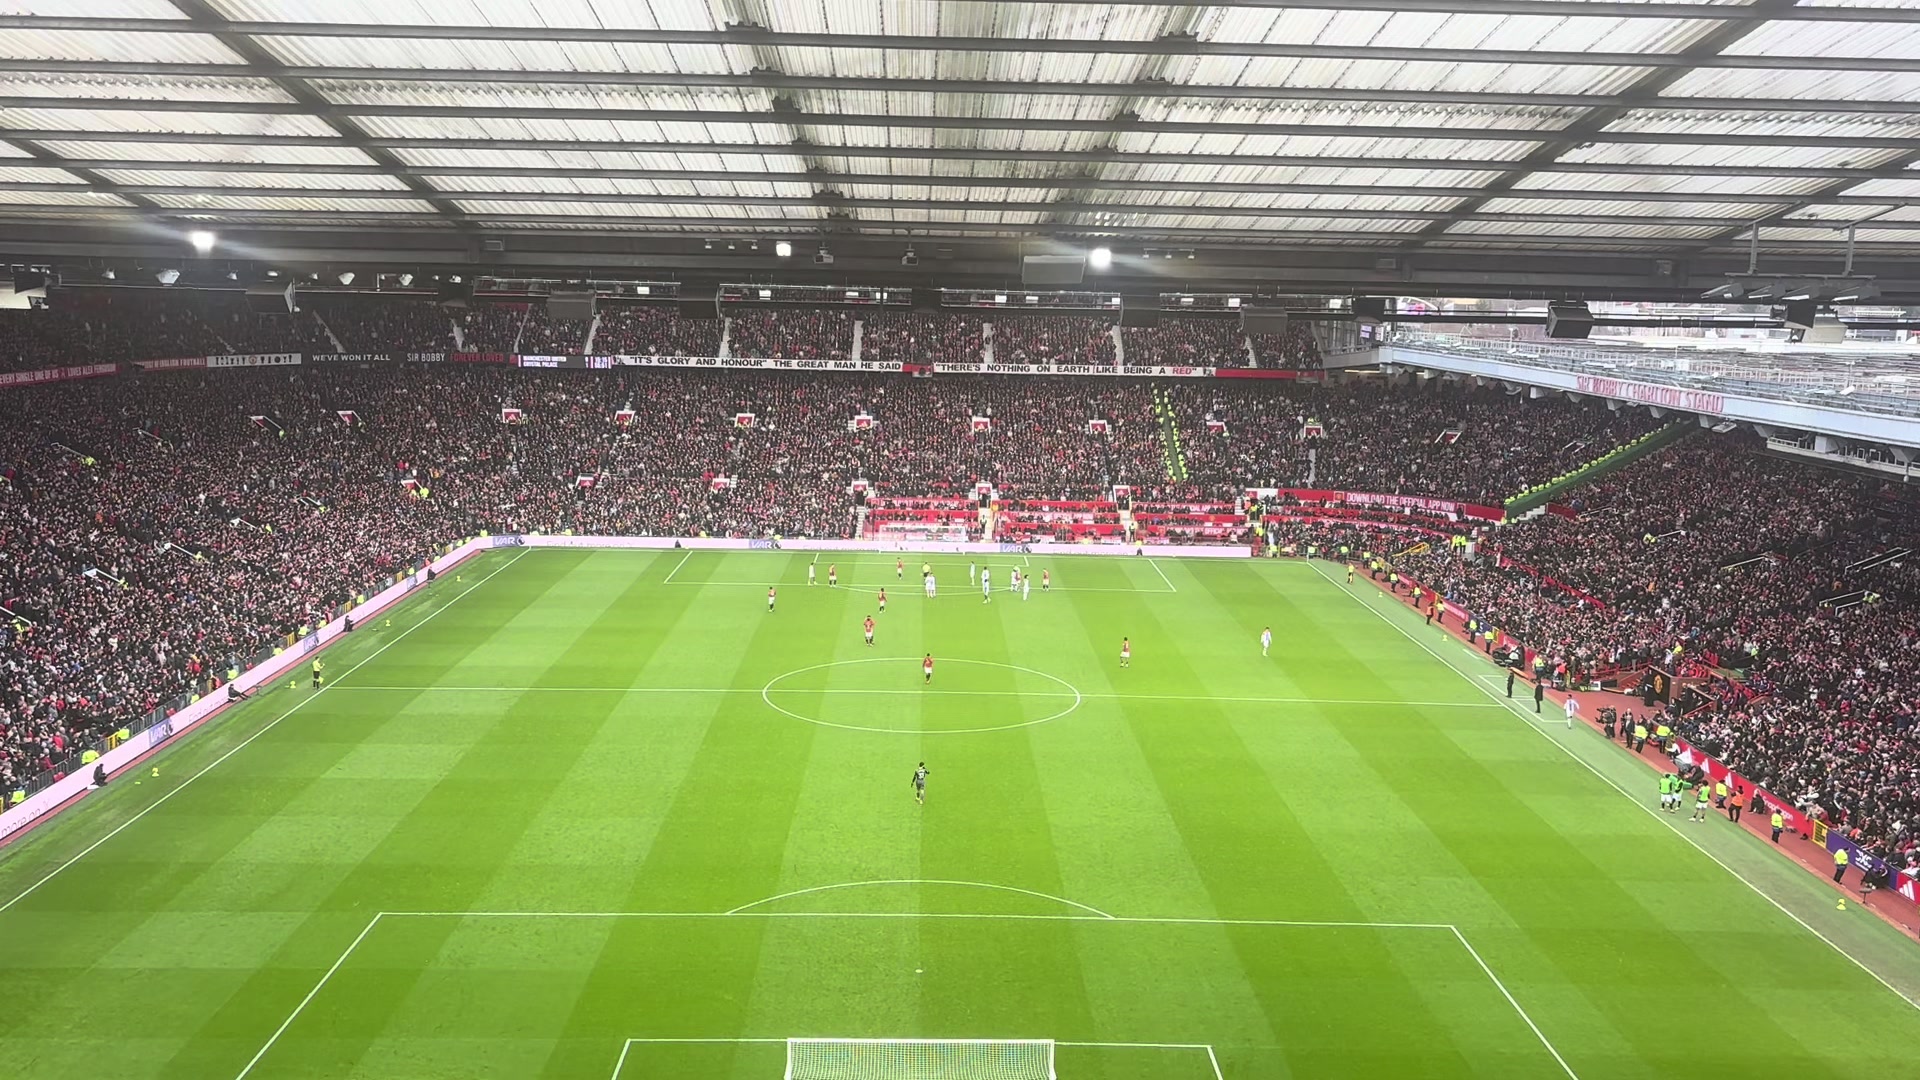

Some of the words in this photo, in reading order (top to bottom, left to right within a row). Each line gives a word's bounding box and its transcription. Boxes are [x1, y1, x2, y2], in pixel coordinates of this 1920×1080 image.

[312, 354, 339, 362] WE'VE
[407, 353, 419, 362] SIR
[421, 353, 445, 362] BOBBY
[630, 356, 652, 364] "IT'S
[658, 357, 690, 365] GLORY
[696, 358, 716, 366] AND
[721, 358, 767, 367] HONOUR"
[773, 359, 792, 368] THE
[797, 360, 829, 369] GREAT
[834, 361, 856, 369] MAN
[860, 362, 873, 370] HE
[878, 362, 901, 370] SAID
[935, 363, 981, 371] "THERE'S
[986, 364, 1031, 372] NOTHING
[1036, 365, 1050, 373] ON
[1057, 365, 1090, 373] EARTH
[1096, 366, 1118, 374] LIKE
[1123, 366, 1152, 375] BEING
[1158, 367, 1166, 375] A
[1172, 367, 1197, 375] RED"
[16, 371, 34, 383] SINGLE
[1577, 375, 1590, 391] SIR
[1592, 376, 1623, 397] BOBBY
[1626, 381, 1681, 407] CHARLTON
[1686, 389, 1725, 415] STAND
[1346, 492, 1385, 505] DOWNLOAD
[1386, 496, 1399, 506] THE
[1399, 496, 1427, 509] OFFICIAL
[1428, 500, 1440, 510] APP
[1441, 501, 1455, 512] NOW
[494, 536, 516, 545] VAR
[751, 540, 774, 549] VAR
[1002, 544, 1023, 553] VAR
[150, 724, 167, 743] VAR
